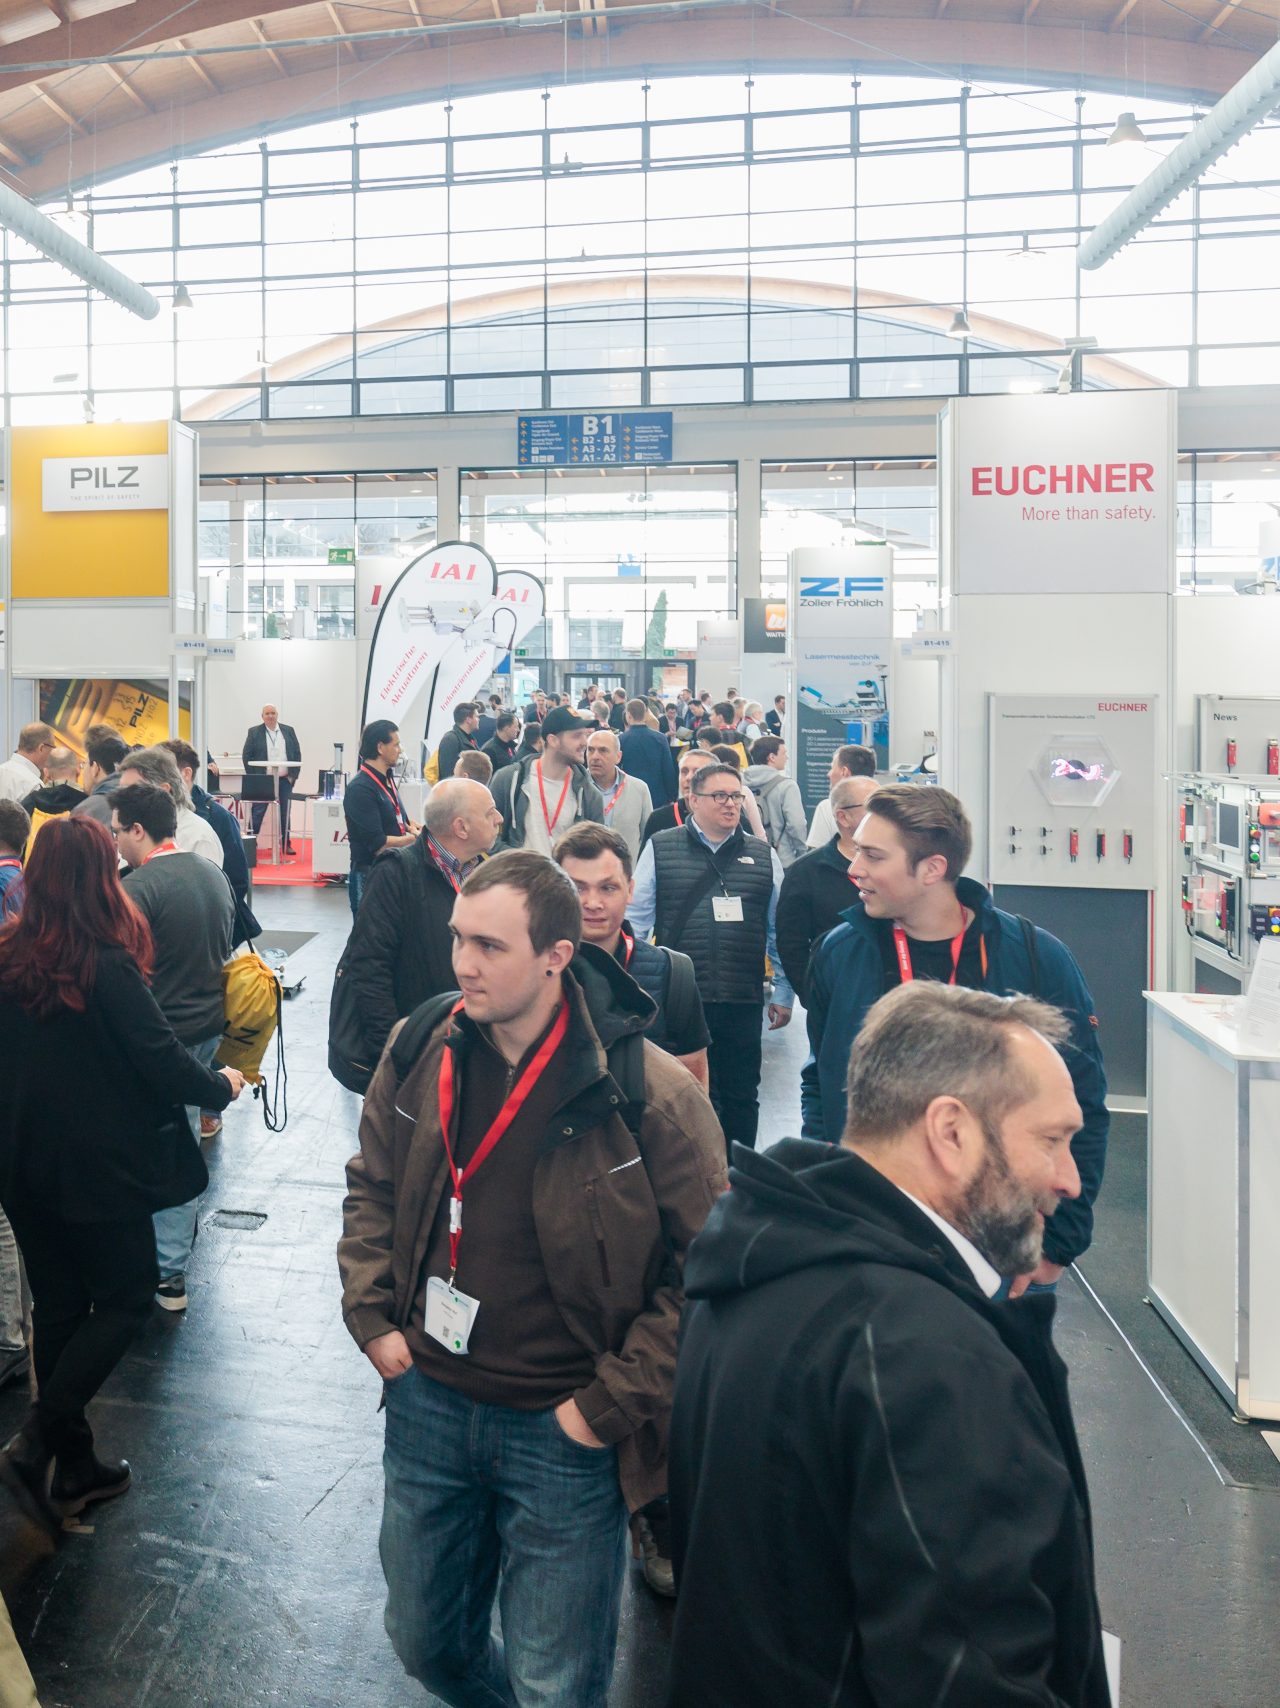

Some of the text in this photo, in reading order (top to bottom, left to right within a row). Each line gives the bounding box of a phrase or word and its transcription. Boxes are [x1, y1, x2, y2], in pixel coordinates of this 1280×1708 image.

[582, 415, 613, 436] B1
[582, 445, 595, 453] A3
[582, 454, 595, 462] A1
[70, 466, 140, 489] PILZ
[972, 463, 1154, 496] EUCHNER
[1022, 505, 1156, 522] More than safety.
[430, 562, 477, 580] IAI
[836, 598, 884, 607] Fröhlich
[380, 645, 417, 700] Elektrische
[391, 651, 429, 706] Aktuatoren
[129, 693, 149, 728] PILZ
[1098, 702, 1148, 712] EUCHNER
[1213, 713, 1238, 721] News
